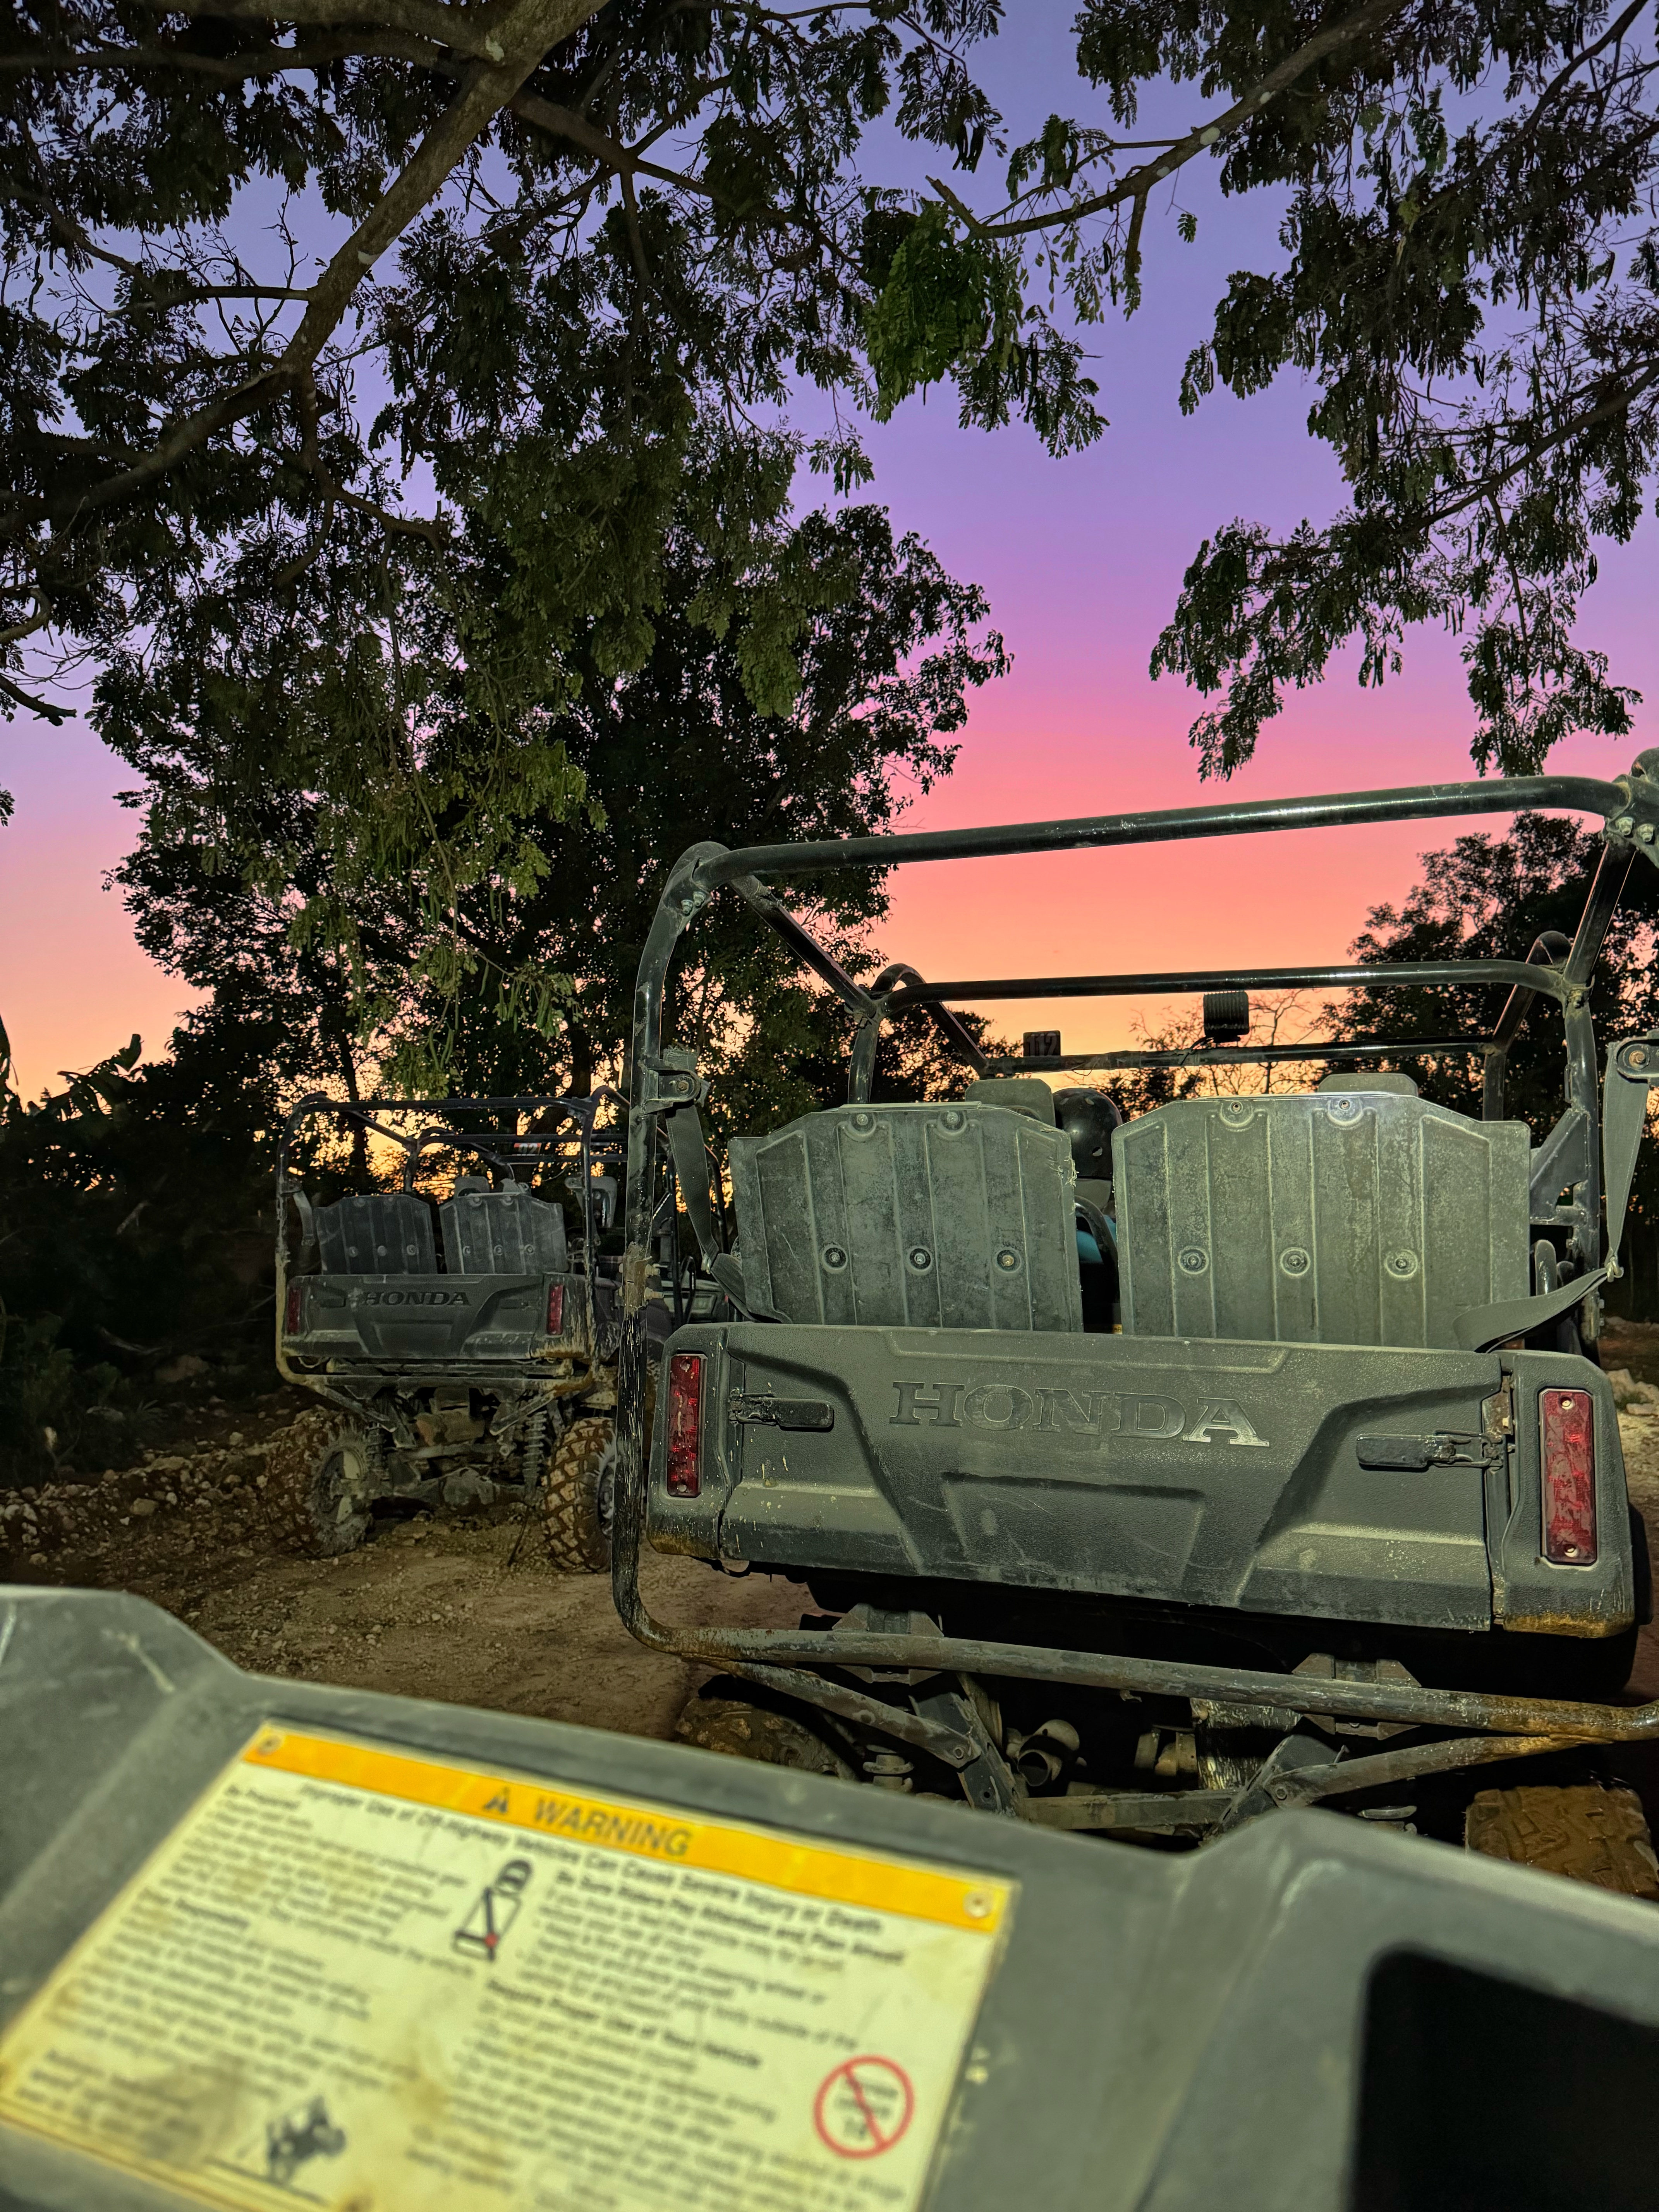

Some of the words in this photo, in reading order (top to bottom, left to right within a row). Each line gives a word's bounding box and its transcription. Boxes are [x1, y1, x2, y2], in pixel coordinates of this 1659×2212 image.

[363, 1291, 472, 1305] HONDA
[889, 1381, 1270, 1448] HONDA
[534, 1796, 694, 1856] WARNING
[584, 1853, 620, 1872] Can
